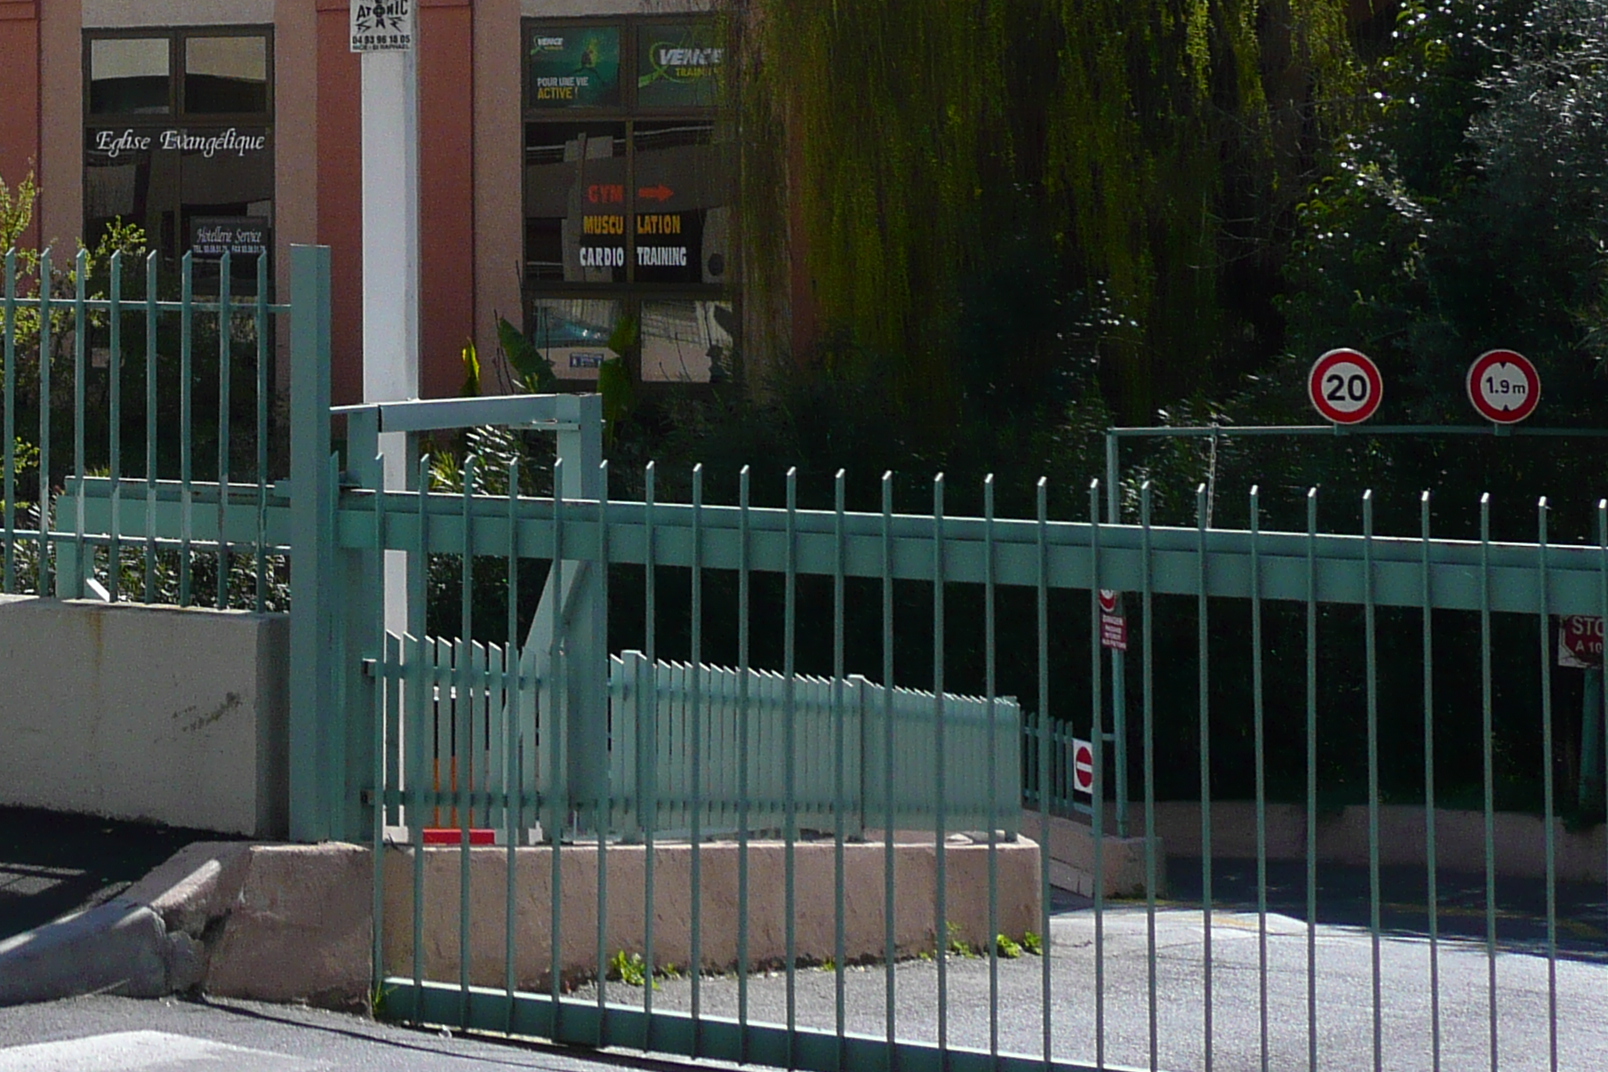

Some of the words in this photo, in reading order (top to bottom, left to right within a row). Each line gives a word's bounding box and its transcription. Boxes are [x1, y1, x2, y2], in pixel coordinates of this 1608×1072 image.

[537, 77, 558, 86] POUR
[575, 77, 589, 86] VIE
[537, 88, 572, 99] ACTIVE
[96, 129, 151, 158] Eglise
[159, 128, 265, 158] Evangélique
[588, 184, 624, 203] GYM
[580, 247, 624, 266] CARDIO
[637, 246, 687, 266] TRAINING
[1325, 374, 1368, 401] 20
[1486, 376, 1510, 394] 1.9
[1512, 382, 1526, 394] m
[1575, 640, 1585, 652] A
